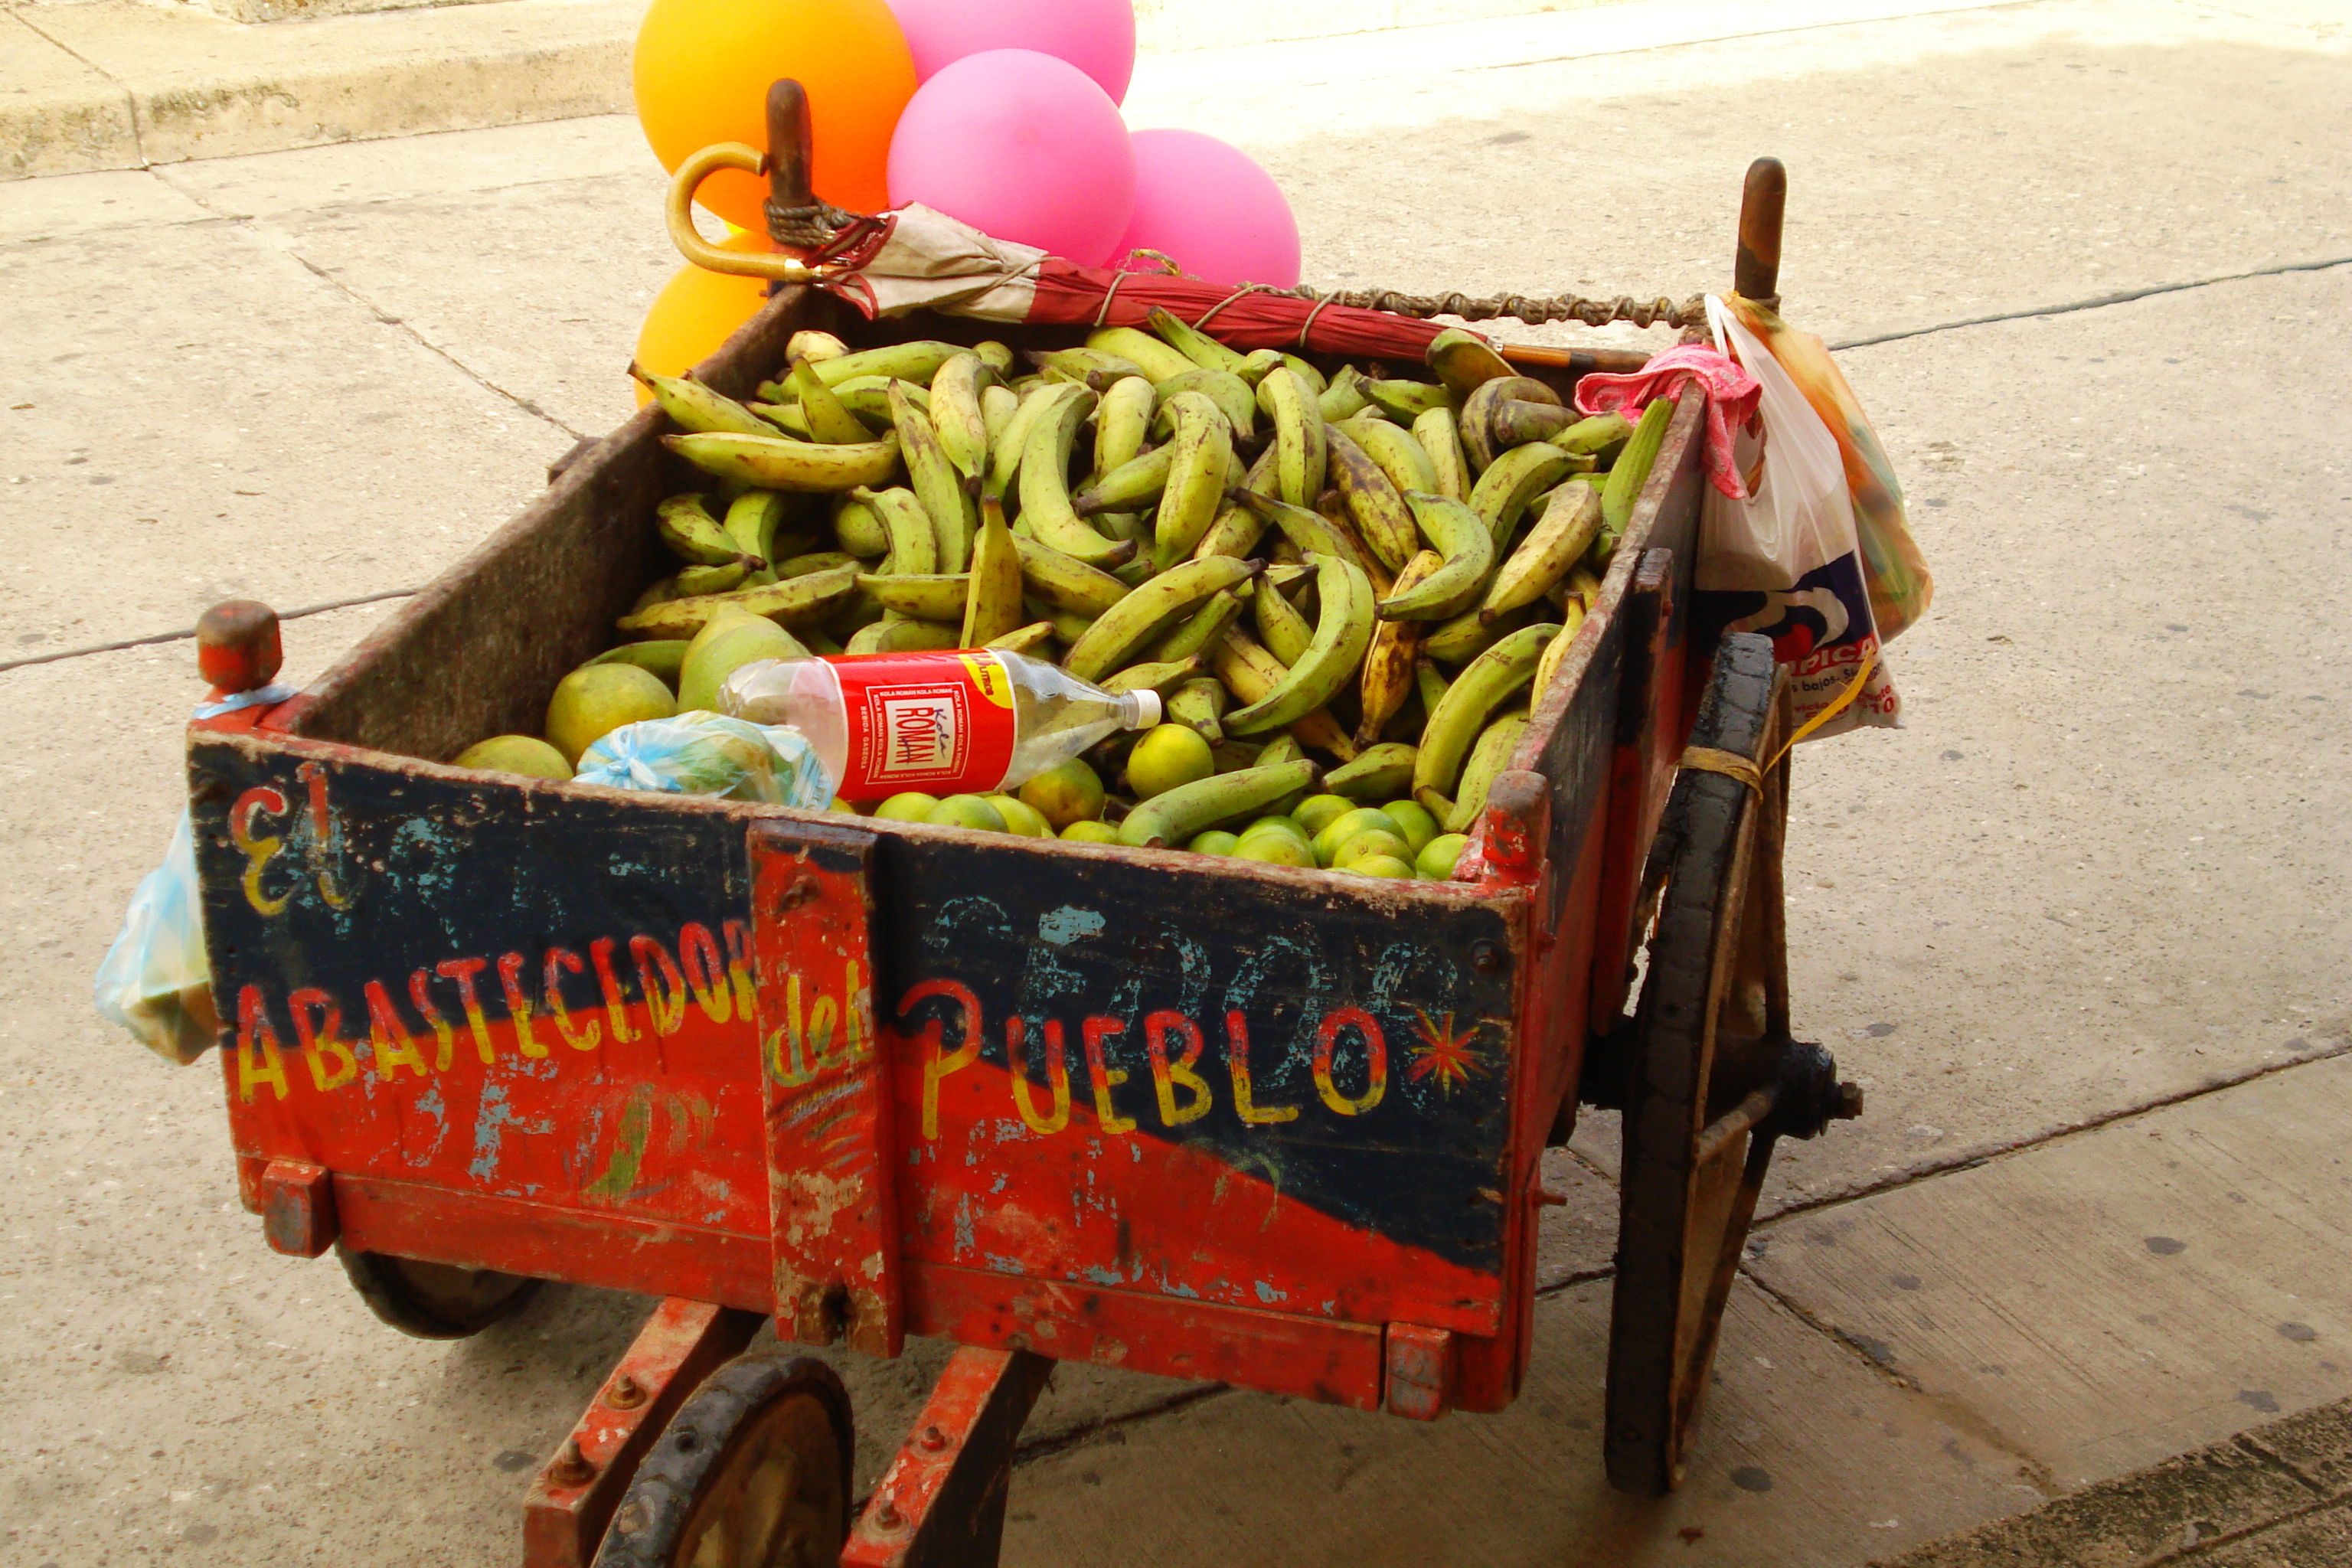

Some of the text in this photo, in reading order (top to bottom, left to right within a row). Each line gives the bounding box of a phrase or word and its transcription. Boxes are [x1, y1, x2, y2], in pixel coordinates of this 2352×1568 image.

[873, 694, 882, 711] KOLA
[860, 706, 869, 769] BEBIDA GASEOSA
[894, 707, 936, 763] ROMAN
[933, 708, 949, 759] Kola
[230, 760, 361, 916] El
[766, 959, 874, 1088] del
[897, 978, 1387, 1141] PUEBLO
